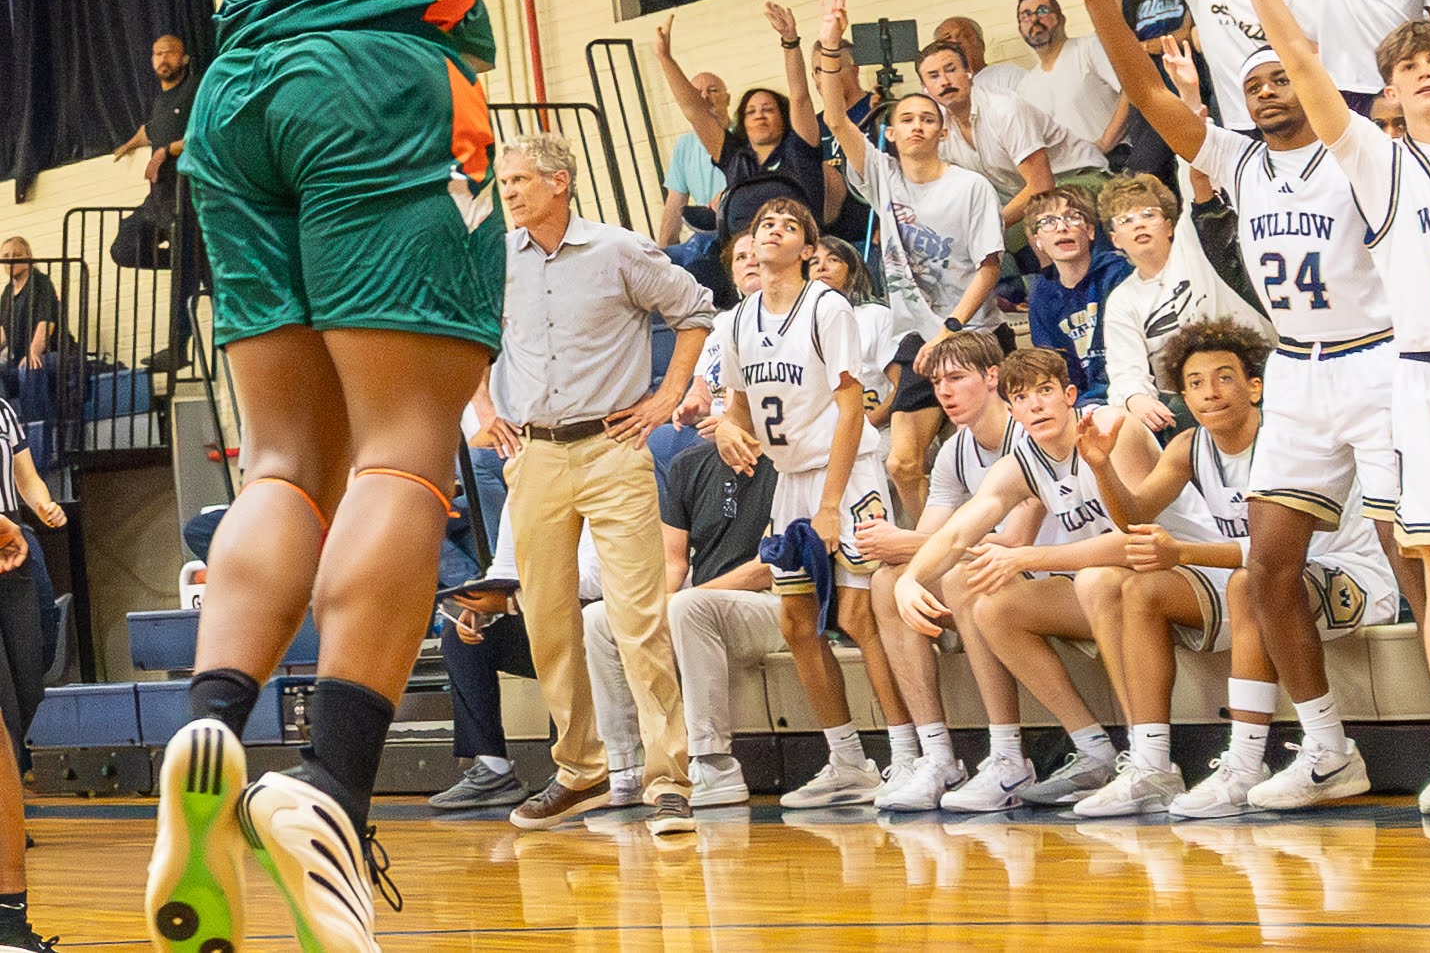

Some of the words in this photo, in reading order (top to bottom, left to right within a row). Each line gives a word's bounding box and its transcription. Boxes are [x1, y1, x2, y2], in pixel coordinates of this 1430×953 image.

[1250, 211, 1335, 241] WILLOW
[1260, 251, 1332, 310] 24
[742, 361, 804, 388] WILLOW
[761, 396, 789, 446] 2
